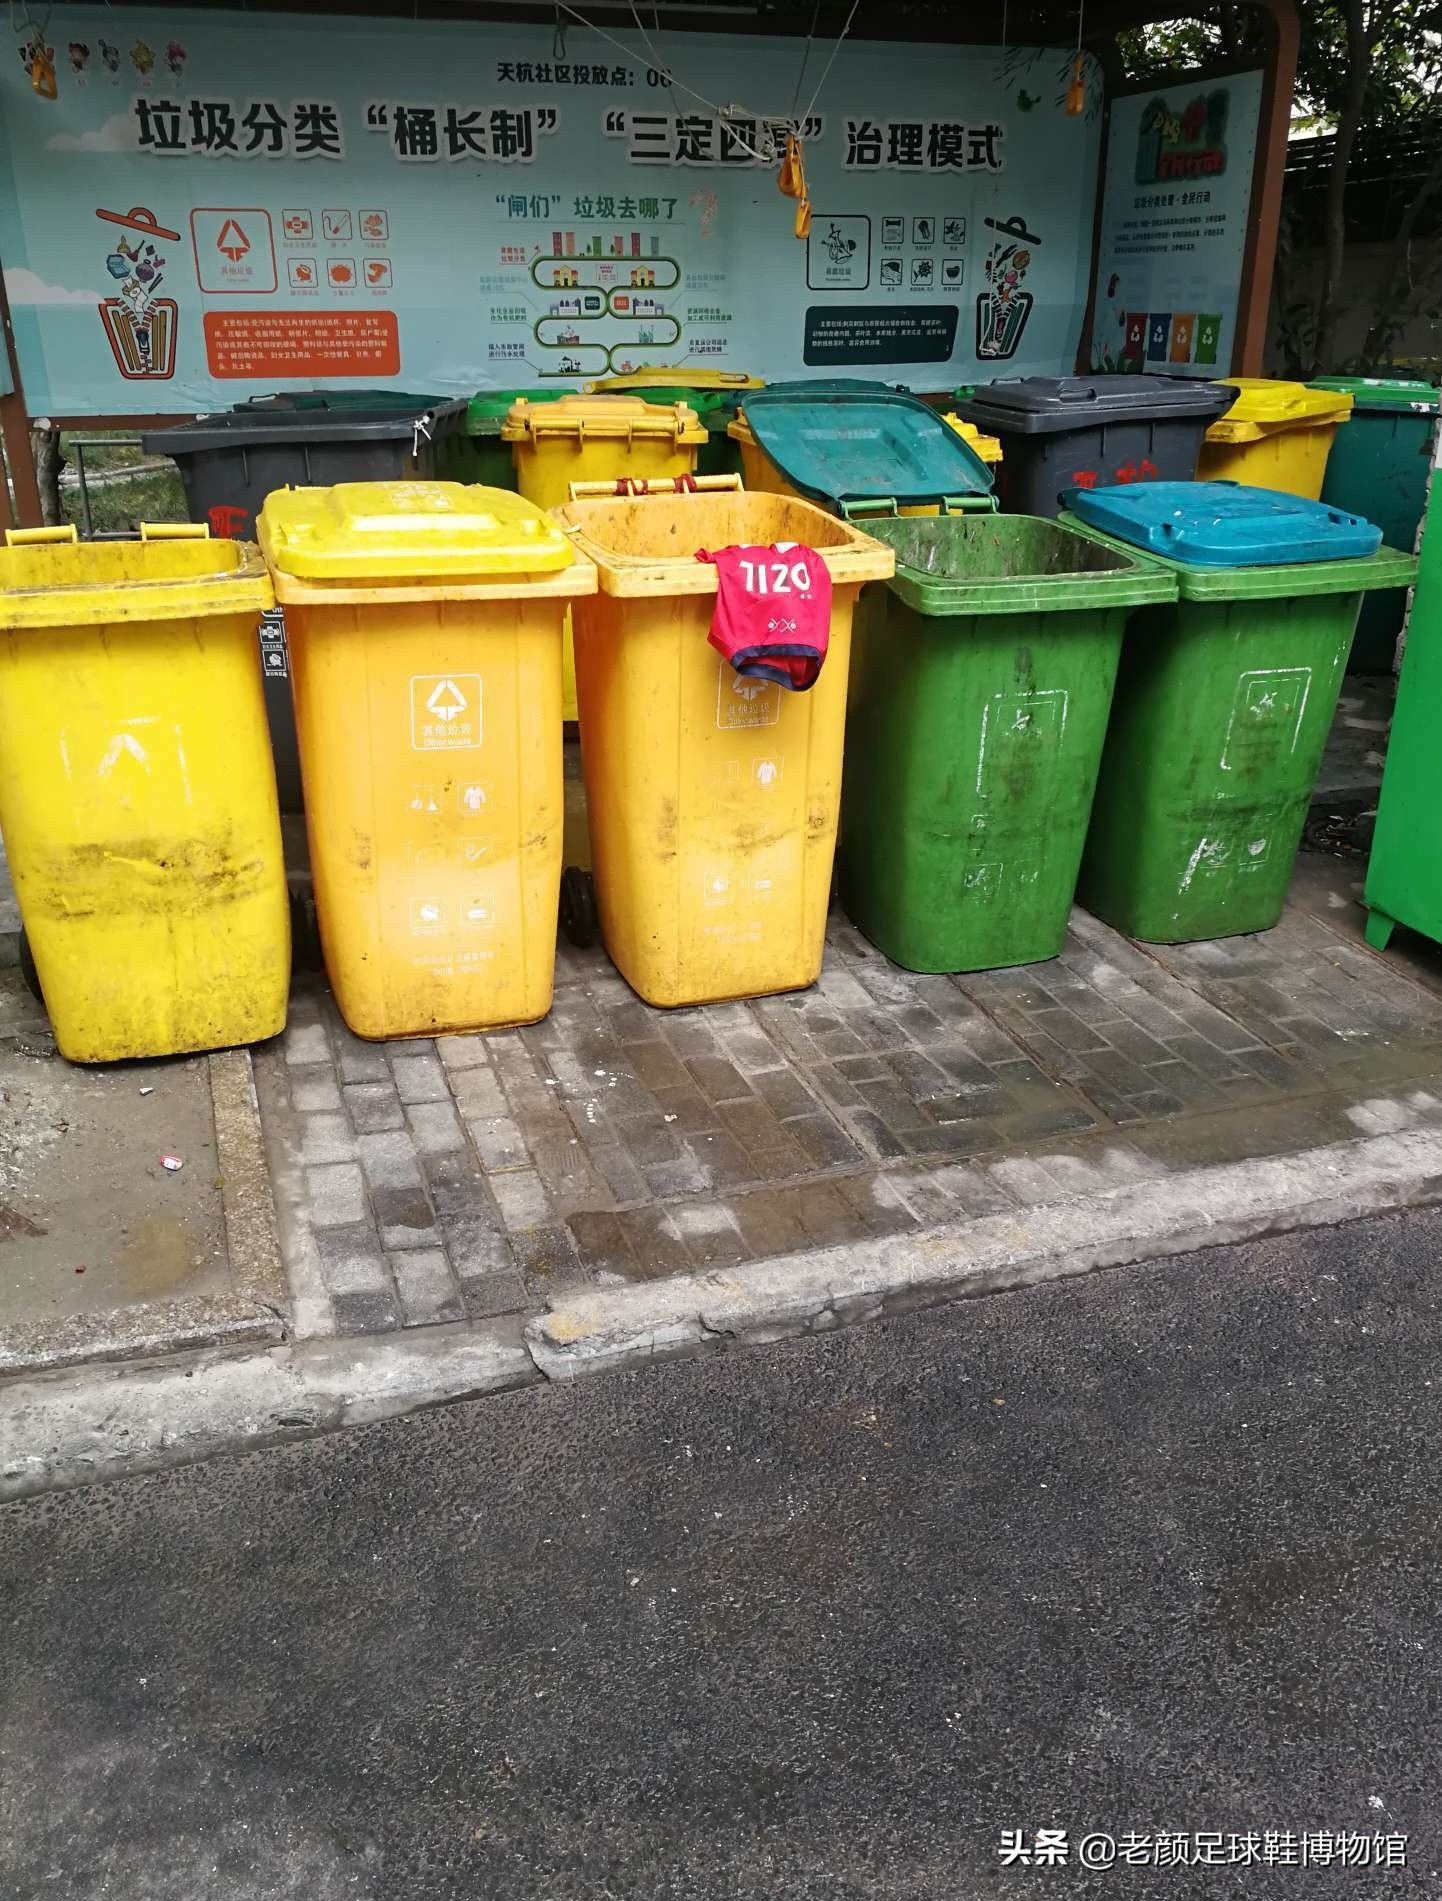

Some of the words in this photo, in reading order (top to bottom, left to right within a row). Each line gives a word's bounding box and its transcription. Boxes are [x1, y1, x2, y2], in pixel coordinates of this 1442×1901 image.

[135, 99, 341, 155] 垃圾分类
[847, 120, 1001, 169] 治理模式
[574, 196, 678, 219] 垃圾去哪了
